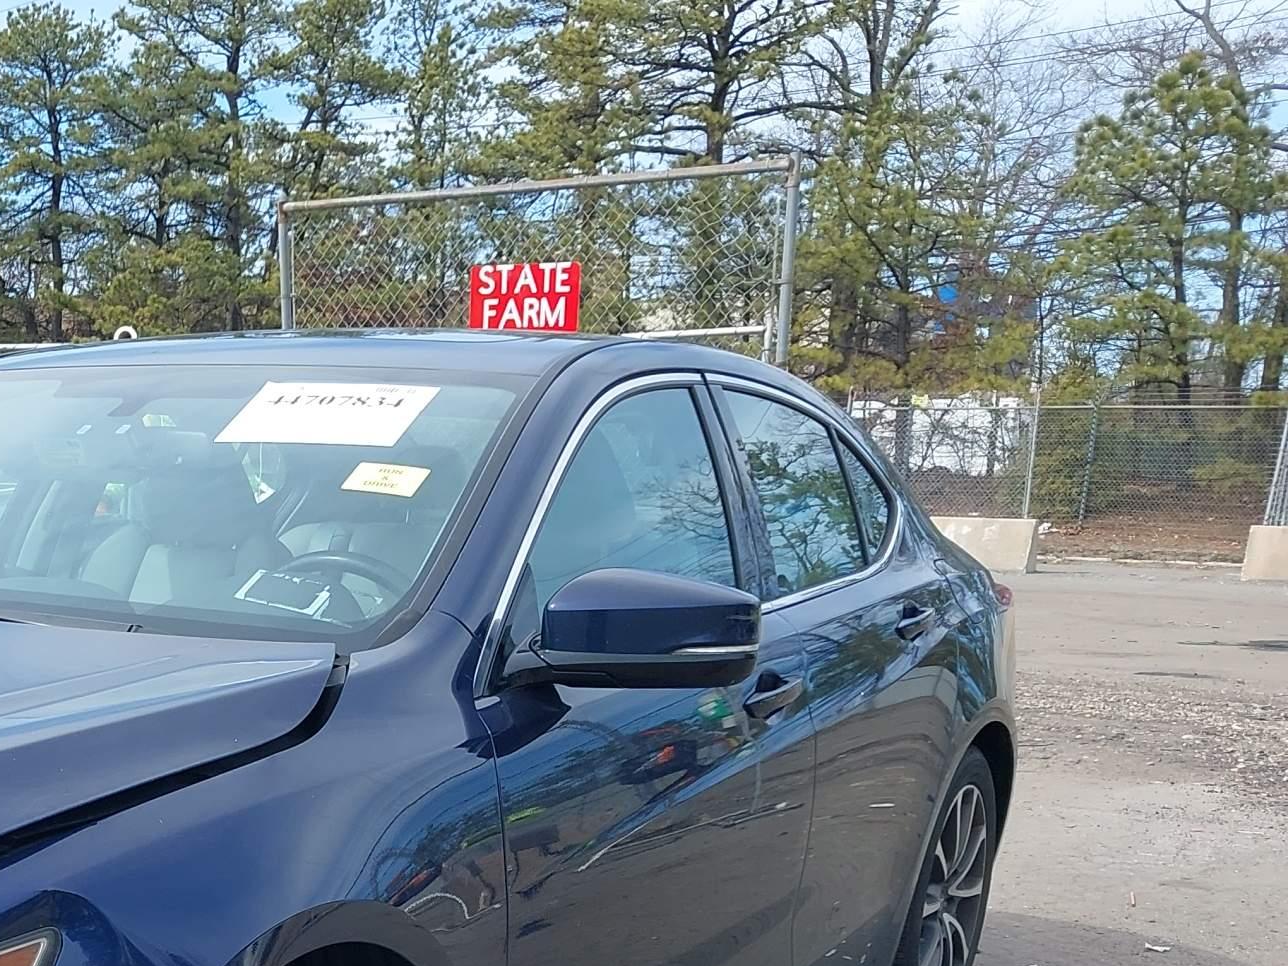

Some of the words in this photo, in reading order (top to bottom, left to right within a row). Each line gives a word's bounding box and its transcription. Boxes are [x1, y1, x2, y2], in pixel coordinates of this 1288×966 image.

[478, 262, 572, 295] STATE
[482, 296, 566, 330] FARM
[267, 395, 404, 407] 44707834
